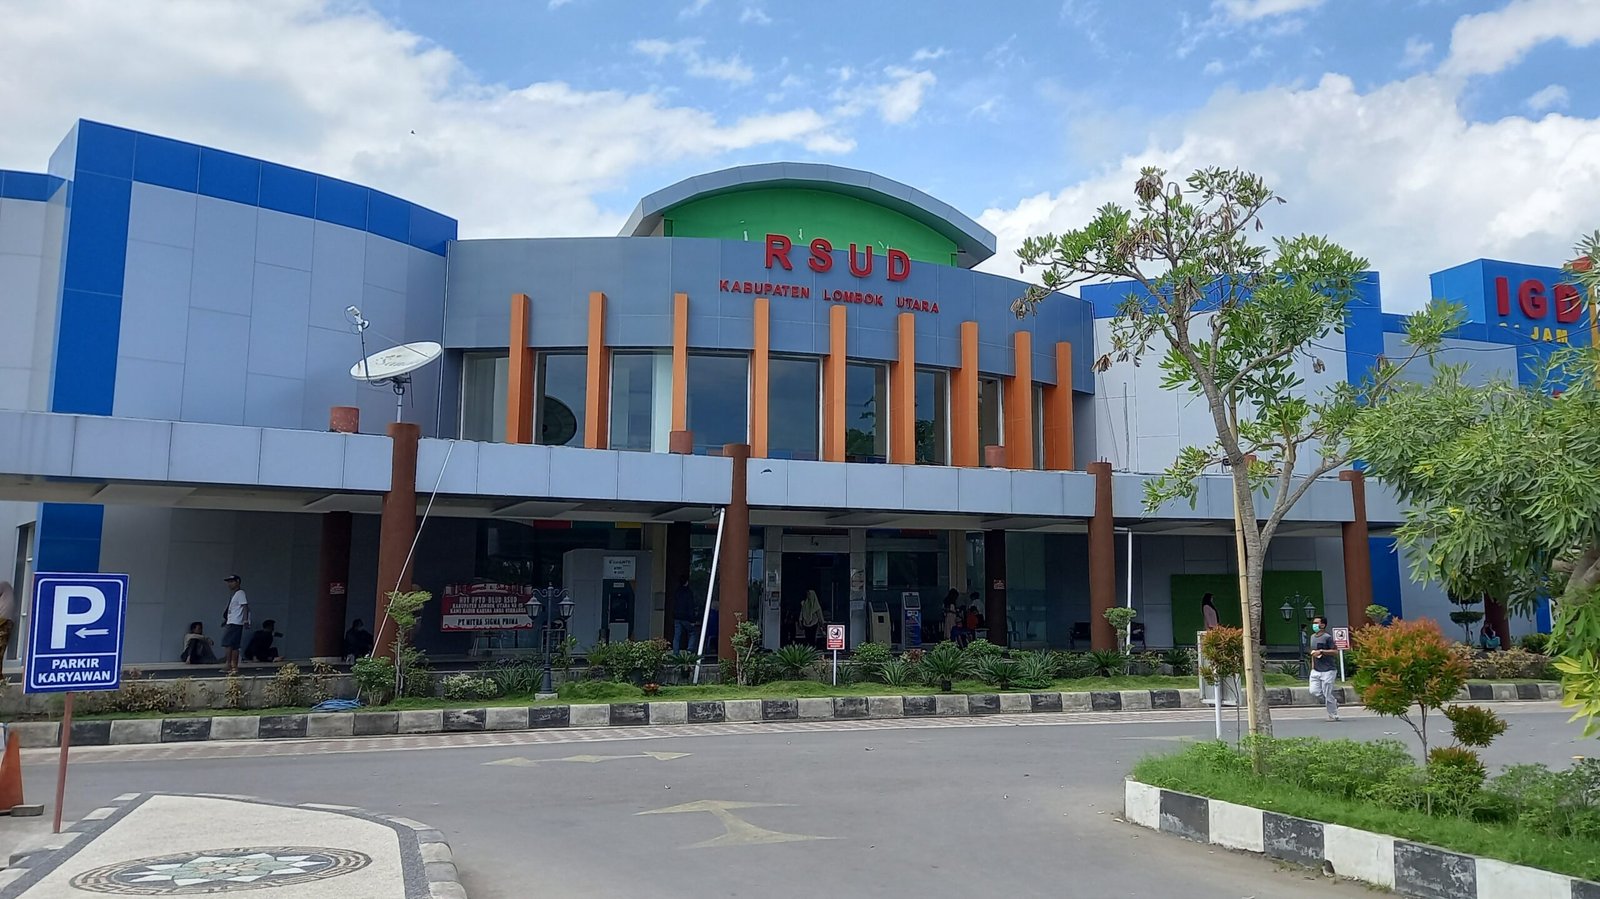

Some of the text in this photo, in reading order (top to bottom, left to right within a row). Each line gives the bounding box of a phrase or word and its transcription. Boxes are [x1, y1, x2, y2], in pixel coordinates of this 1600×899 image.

[765, 234, 911, 282] RSUD
[720, 279, 939, 314] KABUPATEN LOMBOK UTARA
[1495, 276, 1582, 323] IGD
[1531, 326, 1568, 343] JAM
[503, 596, 518, 604] RSUD
[50, 585, 106, 649] P
[38, 670, 111, 683] KARYAWAN
[52, 658, 99, 669] PARKIR
